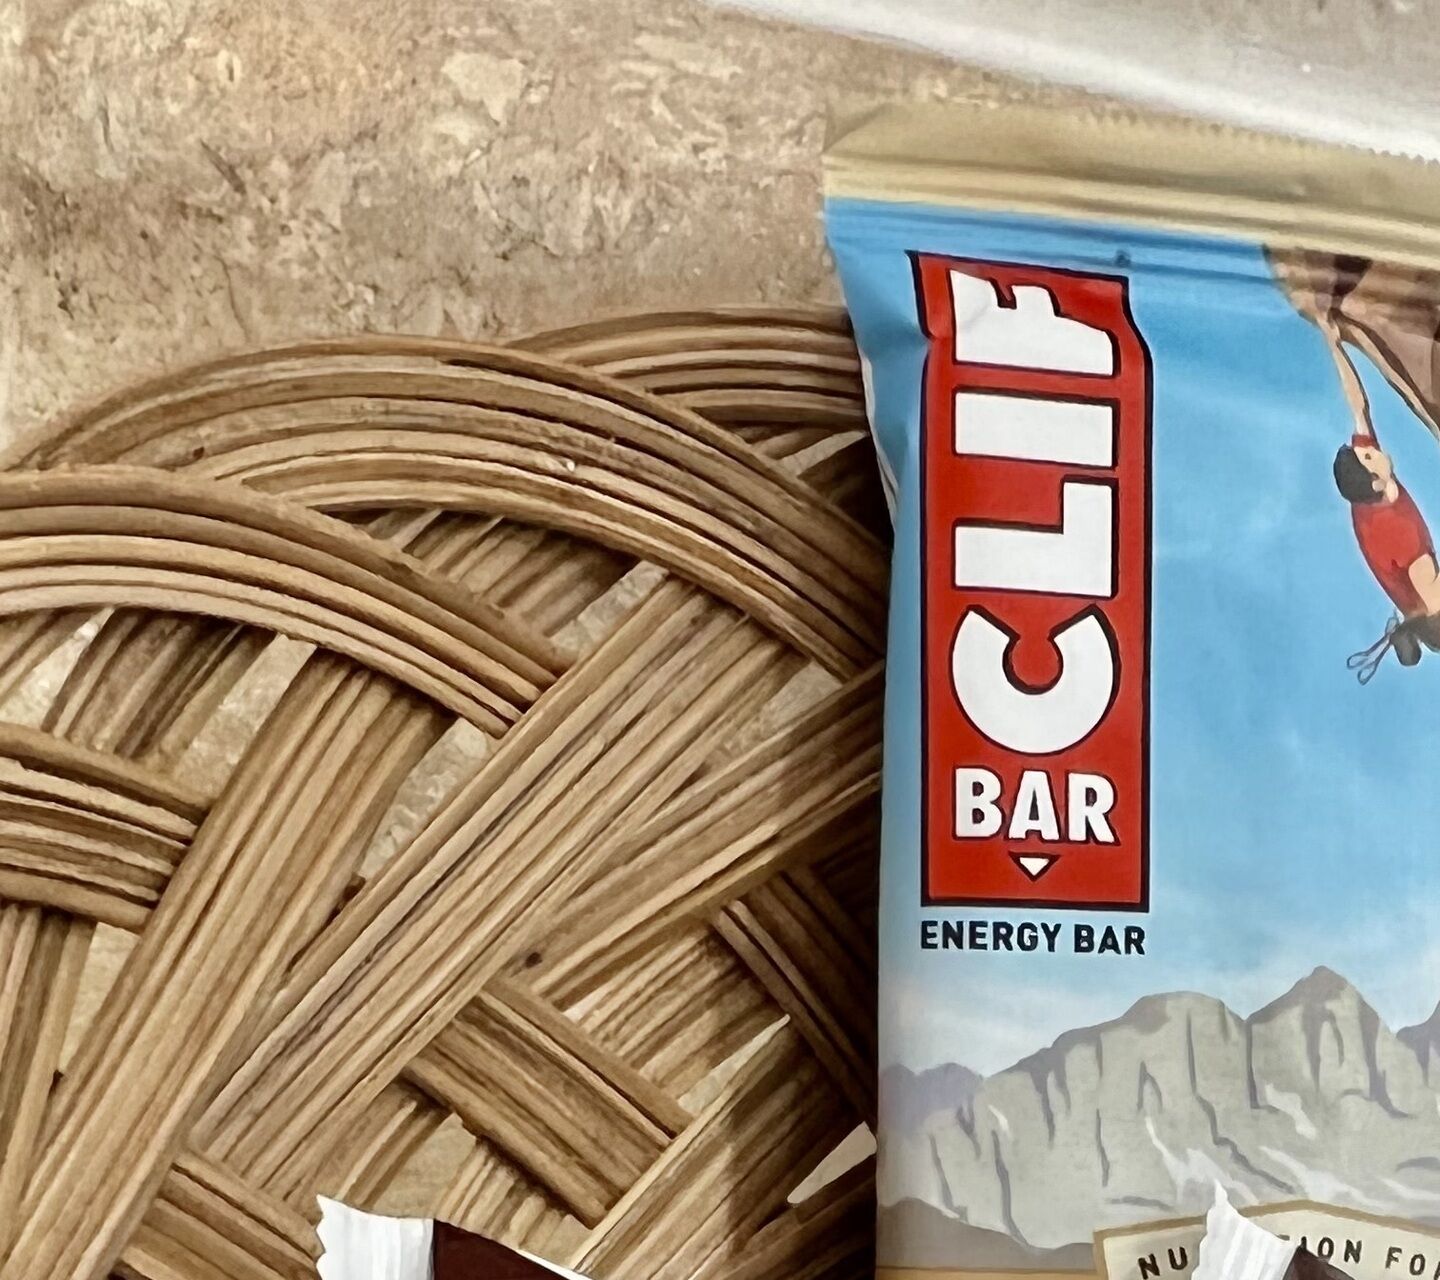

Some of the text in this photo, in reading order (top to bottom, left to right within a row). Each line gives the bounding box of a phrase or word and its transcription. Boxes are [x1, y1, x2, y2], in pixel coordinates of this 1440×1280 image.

[948, 269, 1115, 755] CLIF
[954, 767, 1116, 844] BAR
[920, 919, 1146, 956] ENERGY BAR
